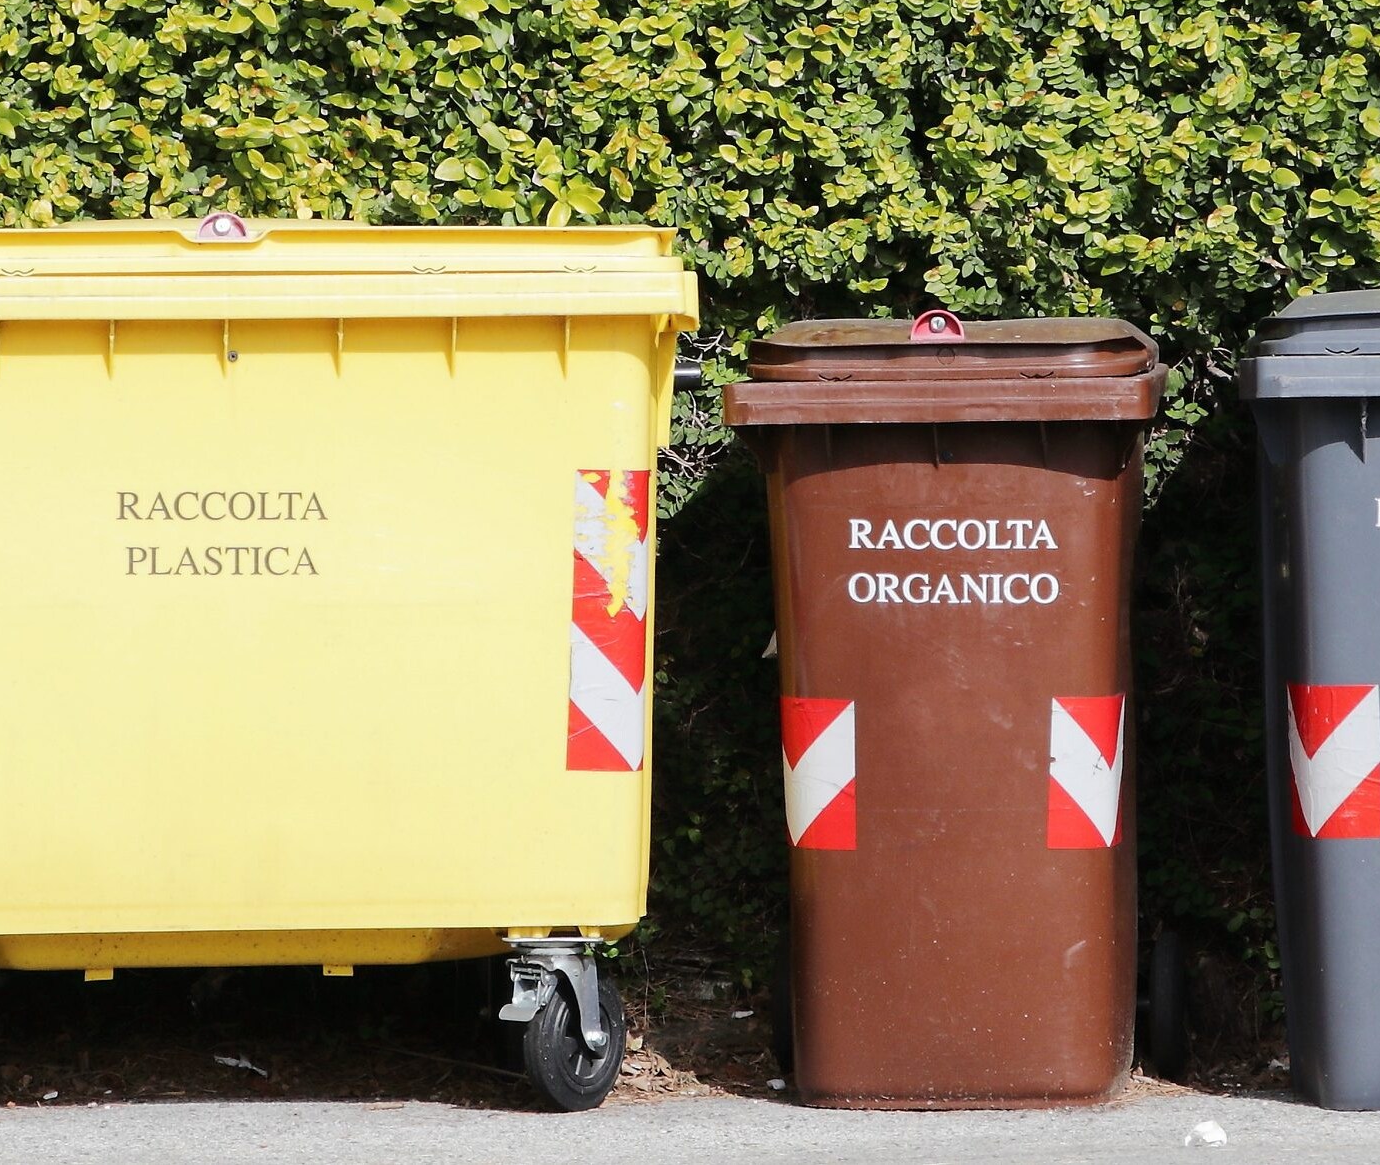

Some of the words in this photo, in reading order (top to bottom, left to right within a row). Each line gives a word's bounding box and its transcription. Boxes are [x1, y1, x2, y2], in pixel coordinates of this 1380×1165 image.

[116, 491, 328, 521] RACCOLTA
[848, 518, 1058, 550] RACCOLTA
[125, 546, 319, 576] PLASTICA
[848, 572, 1059, 604] ORGANICO
